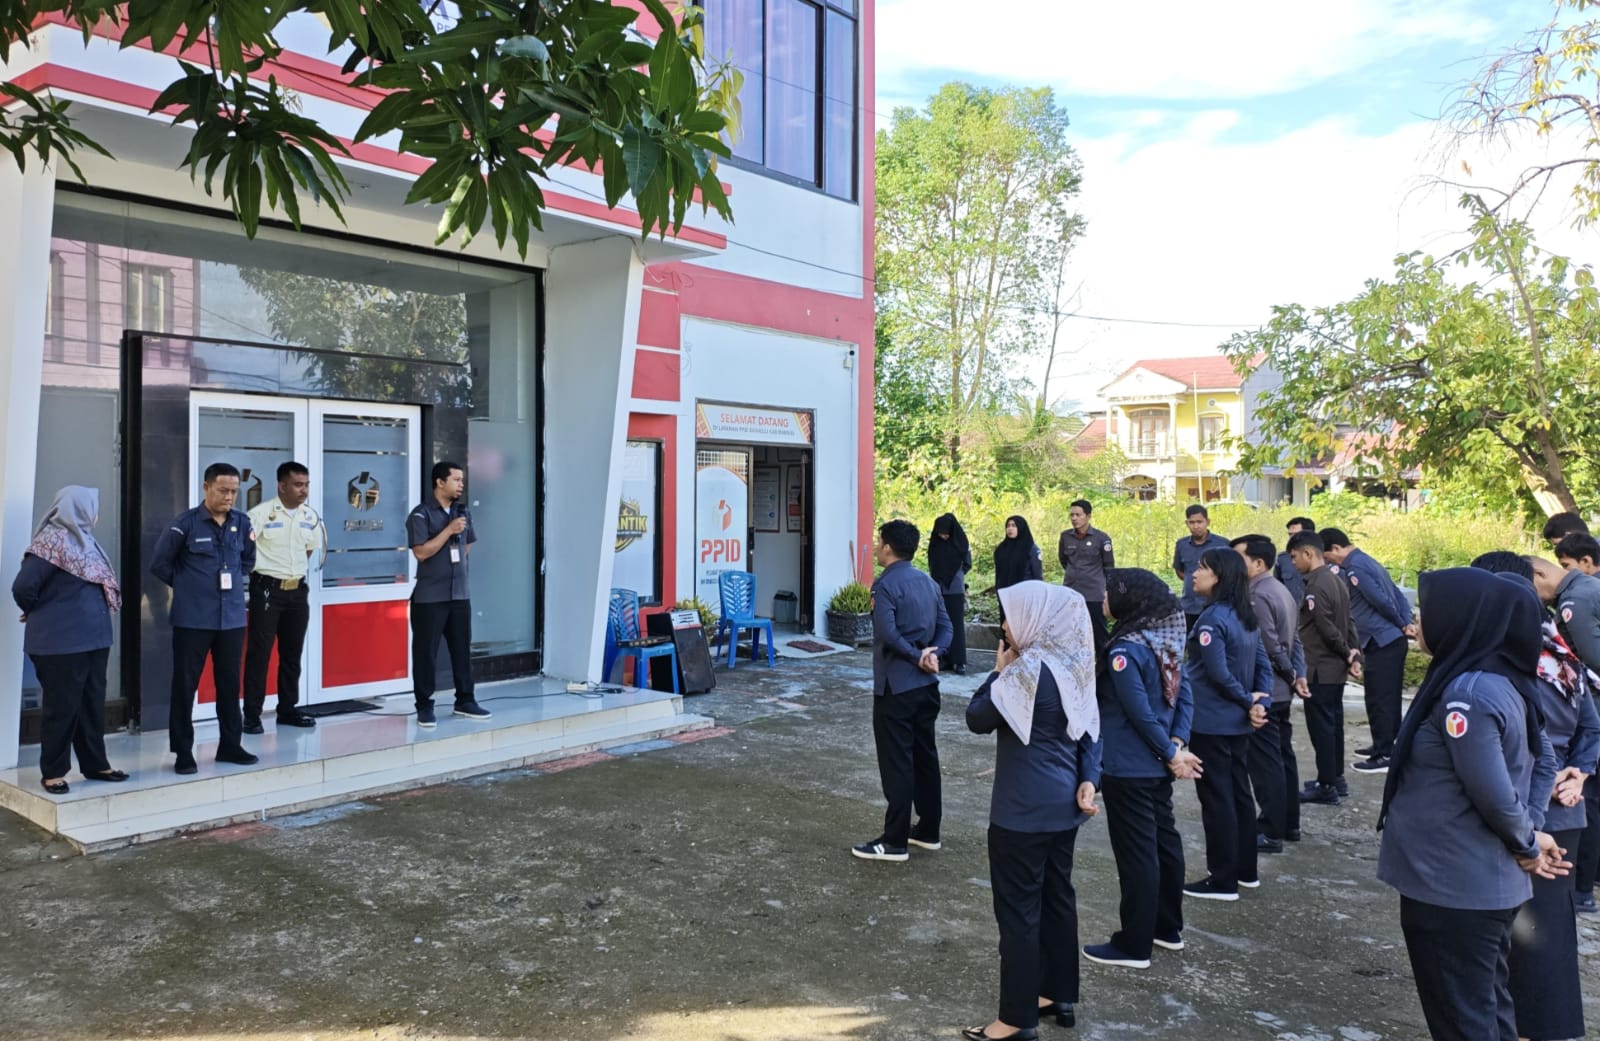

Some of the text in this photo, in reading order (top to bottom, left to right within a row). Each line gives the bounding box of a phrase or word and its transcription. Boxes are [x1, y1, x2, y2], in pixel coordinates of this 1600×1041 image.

[720, 412, 789, 428] SELAMAT DATANG
[701, 539, 741, 563] PPID
